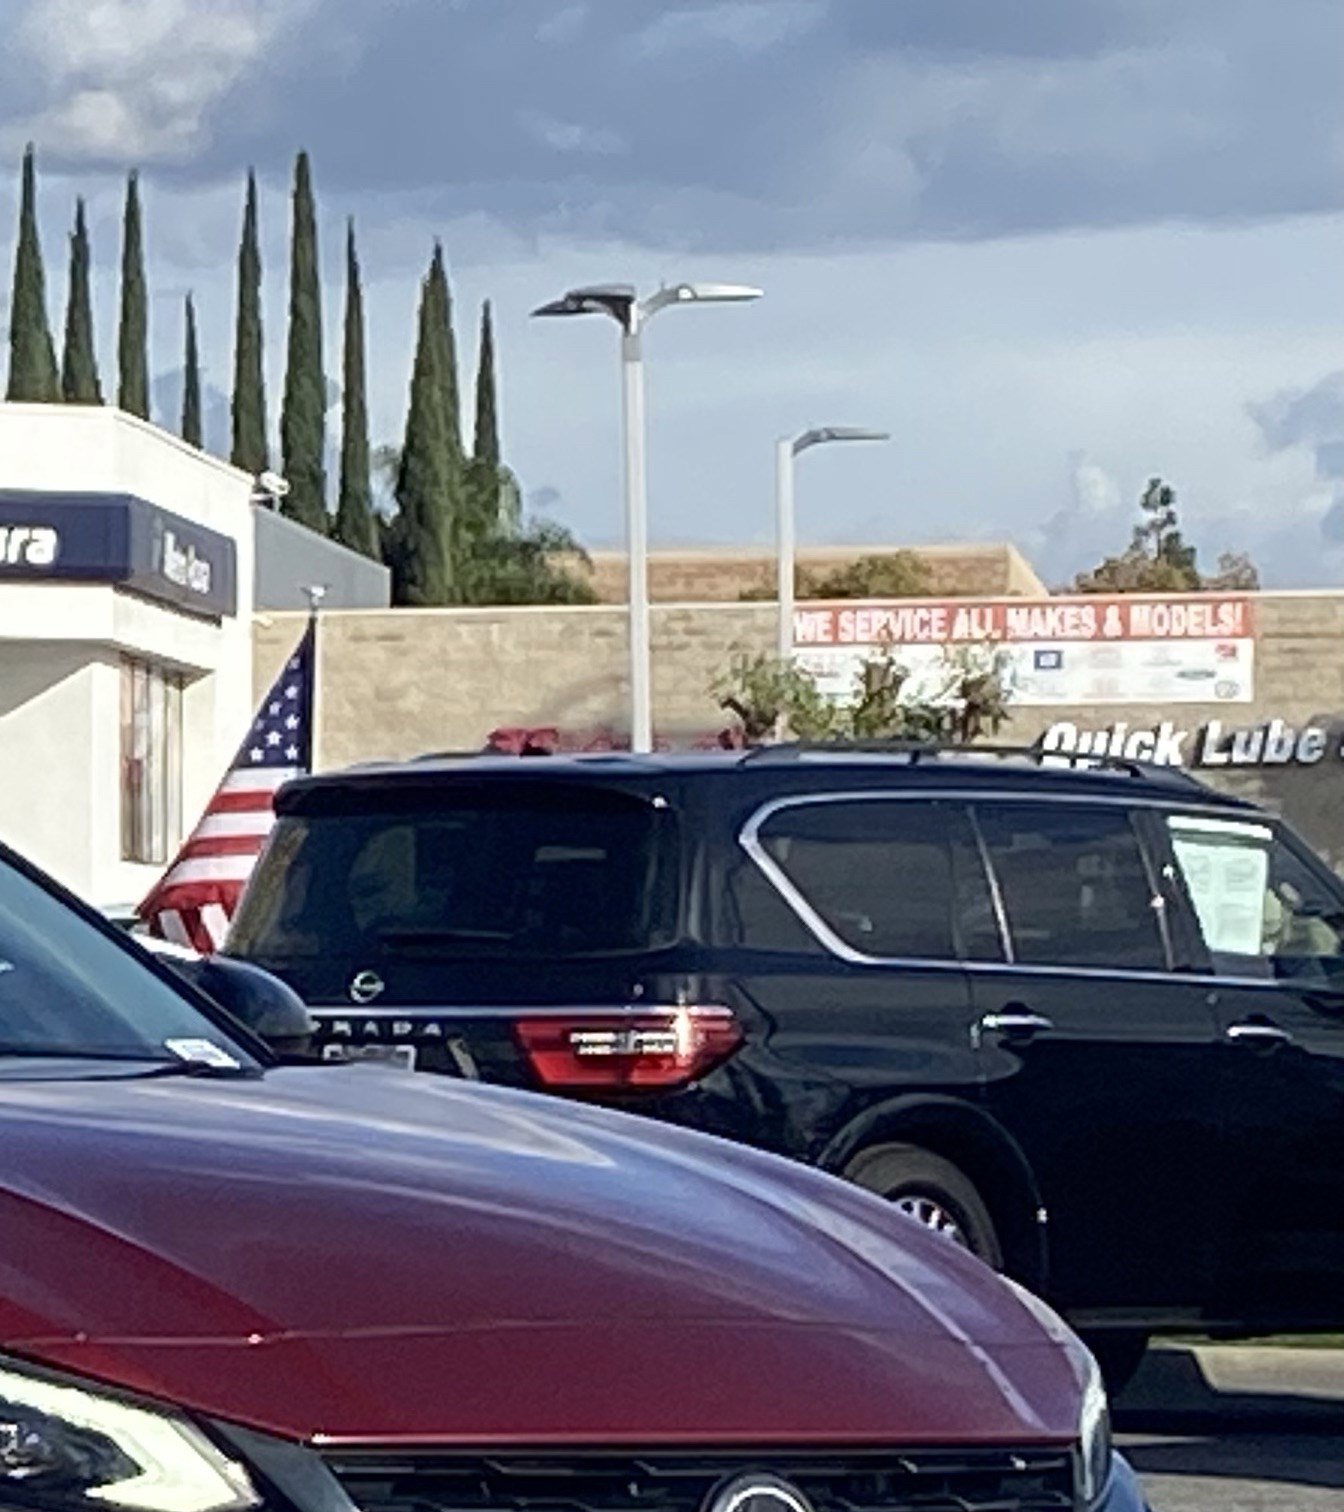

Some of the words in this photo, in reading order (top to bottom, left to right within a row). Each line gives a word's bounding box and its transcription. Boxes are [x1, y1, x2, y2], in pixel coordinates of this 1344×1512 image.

[793, 609, 833, 642] WE
[837, 608, 948, 642] SERVICE
[950, 607, 1002, 640] ALL
[1007, 604, 1097, 639] MAKES
[1129, 602, 1244, 637] MODELS!
[1040, 721, 1188, 769] Quick
[1201, 718, 1327, 764] Lube
